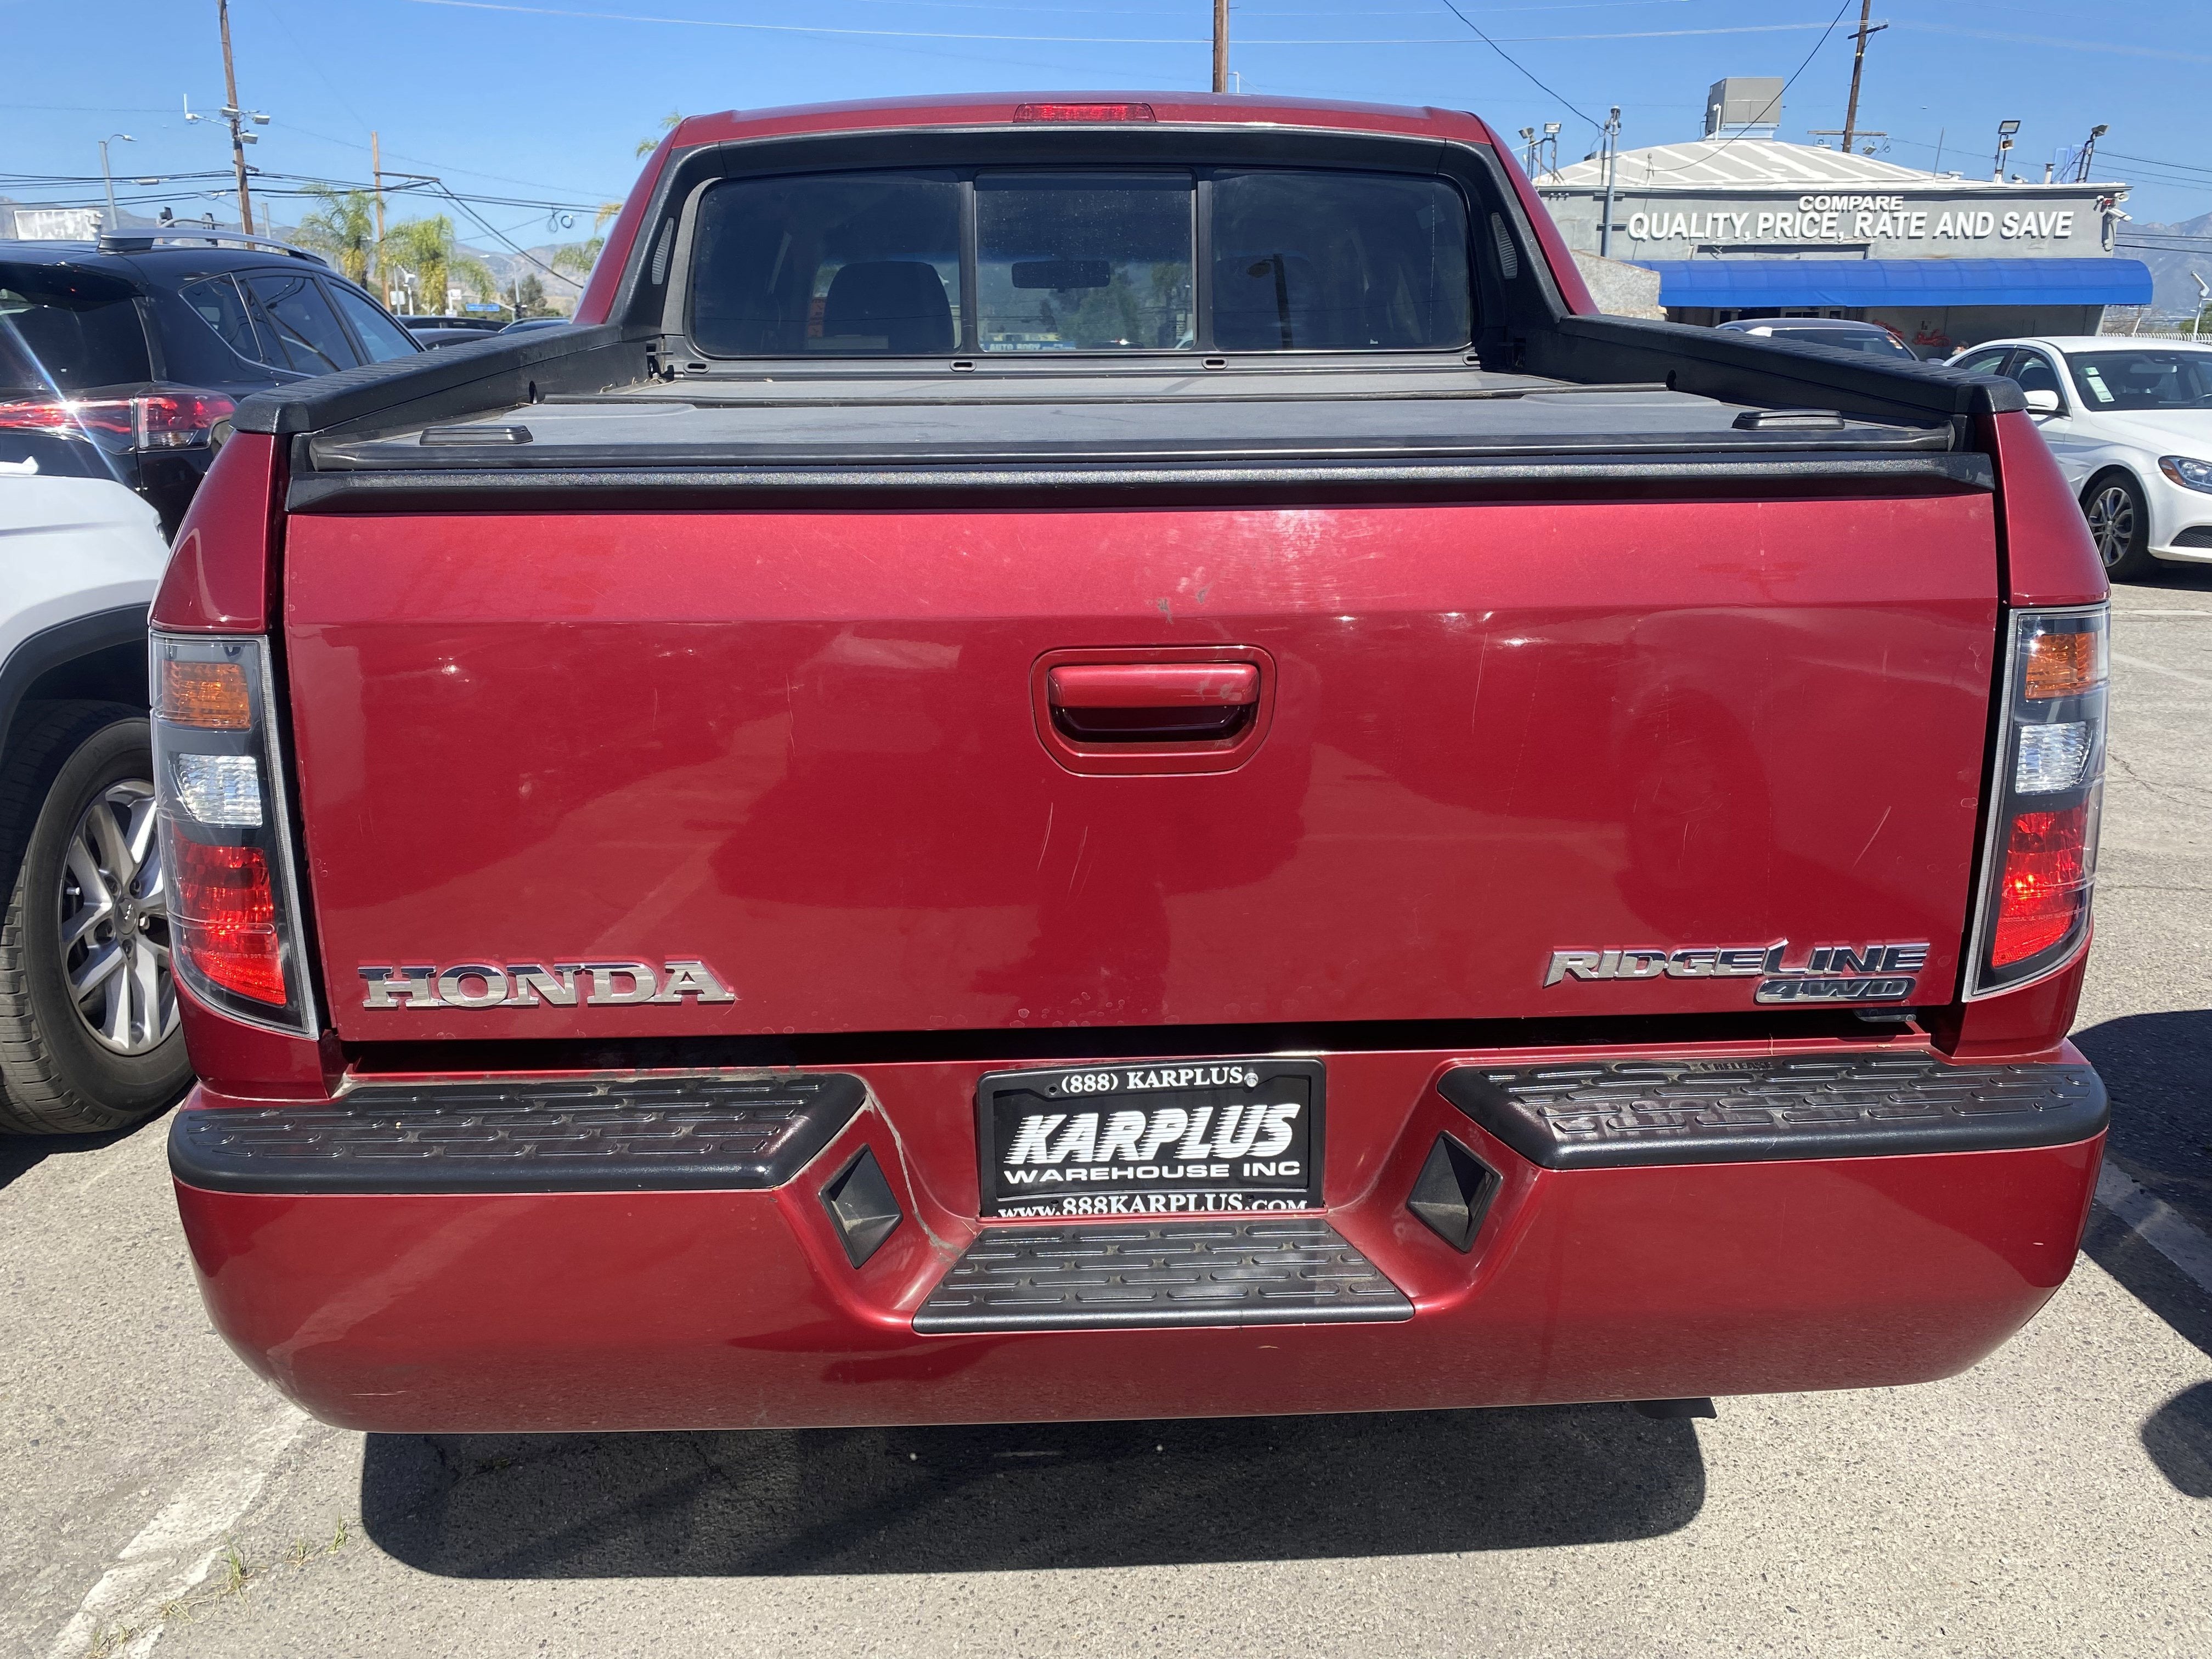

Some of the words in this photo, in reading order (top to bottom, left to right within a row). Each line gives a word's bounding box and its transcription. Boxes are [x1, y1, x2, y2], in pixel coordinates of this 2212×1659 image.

[1799, 195, 1904, 212] COMPARE
[1628, 212, 1750, 241] QUALITY,
[1756, 212, 1844, 242] PRICE,
[1853, 211, 1927, 238] RATE
[1933, 211, 1994, 238] AND
[2000, 211, 2074, 239] SAVE
[1543, 938, 1931, 986] RIDGELINE
[358, 960, 736, 1008] HONDA
[1763, 979, 1909, 1001] 4WD
[1061, 1073, 1119, 1094] (888)
[1127, 1066, 1243, 1090] KARPLUS
[1713, 1062, 1774, 1070] RELEASE
[1003, 1103, 1301, 1164] KARPLUS
[1004, 1164, 1229, 1184] WAREHOUSE
[1243, 1161, 1300, 1177] INC
